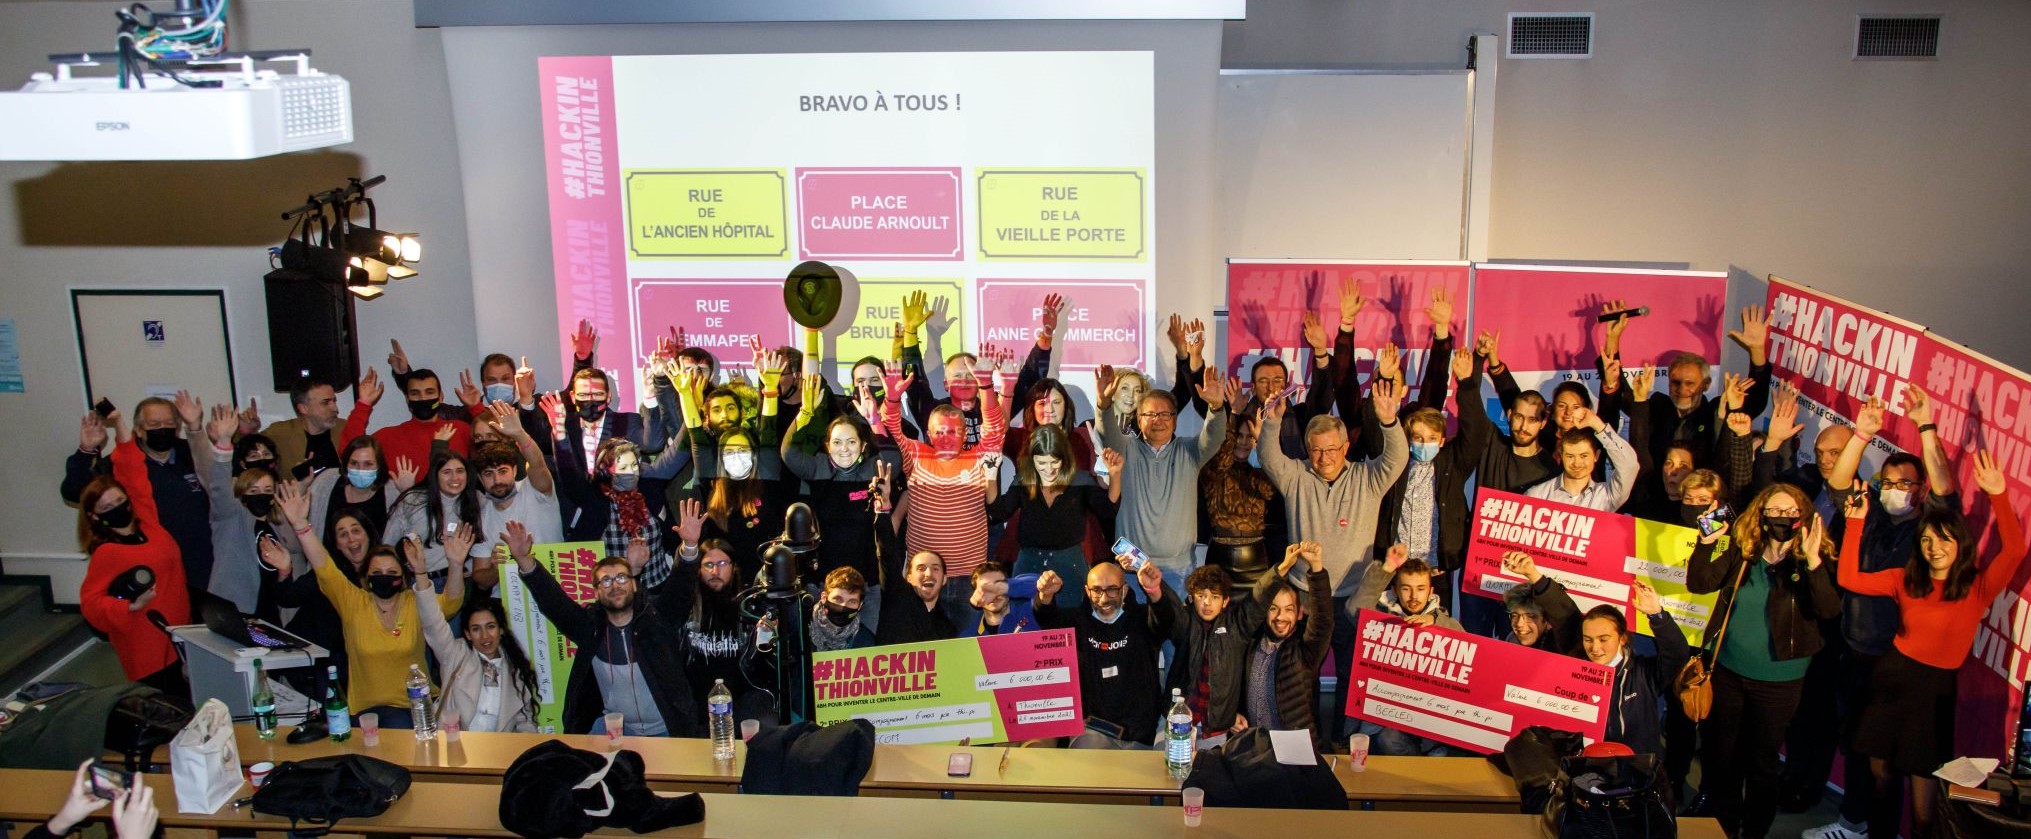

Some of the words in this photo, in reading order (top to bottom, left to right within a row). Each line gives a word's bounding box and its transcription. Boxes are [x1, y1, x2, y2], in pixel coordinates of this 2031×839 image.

[799, 95, 868, 112] BRAVO
[874, 90, 888, 111] À
[893, 94, 948, 112] TOUS
[956, 93, 961, 111] !
[96, 122, 130, 131] EPSON
[555, 76, 586, 199] #HACKIN
[579, 77, 605, 197] THIONVILLE
[688, 189, 723, 202] RUE
[1042, 187, 1078, 200] RUE
[851, 195, 908, 209] PLACE
[698, 207, 716, 218] DE
[1041, 210, 1059, 221] DE
[1063, 210, 1080, 221] LA
[811, 216, 873, 230] CLAUDE
[876, 216, 950, 230] ARNOULT
[642, 225, 709, 239] L'ANCIEN
[712, 222, 775, 238] HÔPITAL
[996, 228, 1061, 241] VIEILLE
[1066, 228, 1126, 242] PORTE
[696, 299, 730, 313] RUE
[866, 306, 900, 319] RUE
[1032, 308, 1089, 321] PCE
[705, 317, 723, 328] DE
[987, 328, 1029, 341] ANNE
[1770, 291, 1918, 380] #HACKIN
[1577, 373, 1591, 381] AU
[1768, 331, 1912, 417] THIONVILLE
[1816, 408, 1825, 417] LE
[1480, 498, 1595, 539] #HACKIN
[1480, 518, 1591, 558] THIONVILLE
[1483, 558, 1501, 568] PRIX
[1637, 561, 1649, 570] 22
[1034, 641, 1066, 649] NOVEMBRE
[1362, 619, 1478, 666] #HACKIN
[813, 650, 936, 682] #HACKIN
[1043, 658, 1063, 668] PRIX
[1362, 640, 1472, 685] THIONVILLE
[1009, 675, 1016, 684] 6
[1046, 671, 1056, 680] €
[1588, 667, 1597, 675] AU
[1571, 672, 1604, 685] NOVEMBRE
[815, 672, 938, 701] THIONVILLE
[876, 694, 911, 704] CENTRE-VILLE
[1554, 686, 1576, 700] Coup
[1578, 692, 1589, 701] de
[1427, 697, 1433, 706] 6
[1571, 705, 1581, 713] €
